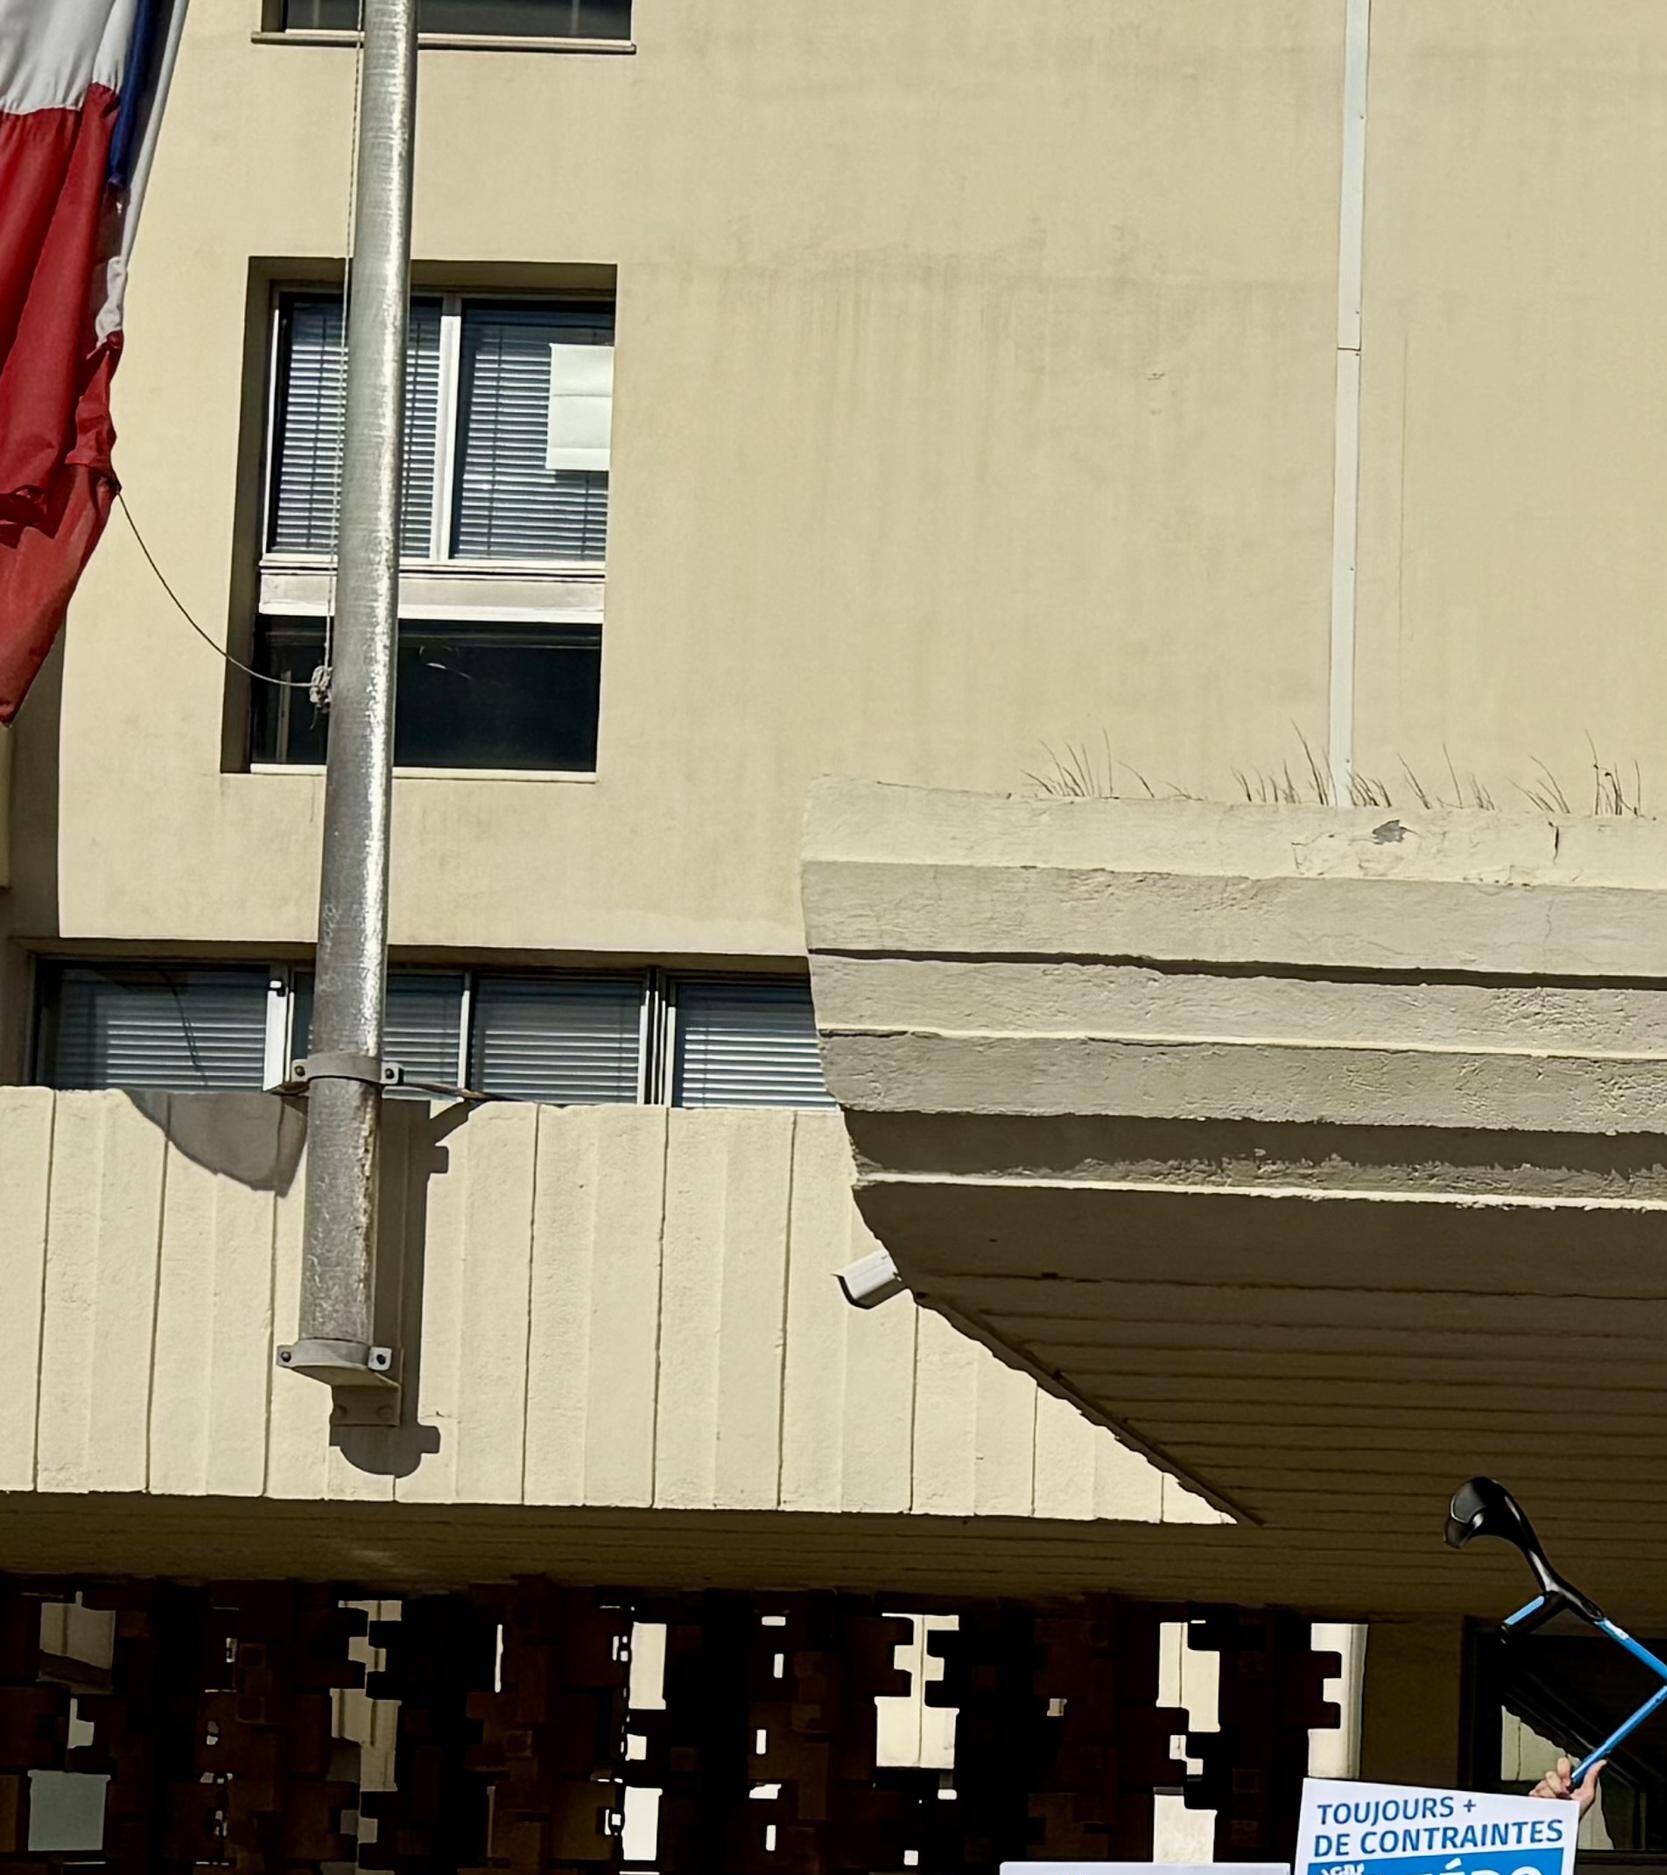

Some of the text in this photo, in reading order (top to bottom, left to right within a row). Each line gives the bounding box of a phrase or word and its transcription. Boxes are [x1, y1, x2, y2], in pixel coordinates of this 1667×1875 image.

[1316, 1795, 1477, 1827] TOUJOURS +
[1313, 1819, 1564, 1858] DE CONTRAINTES
